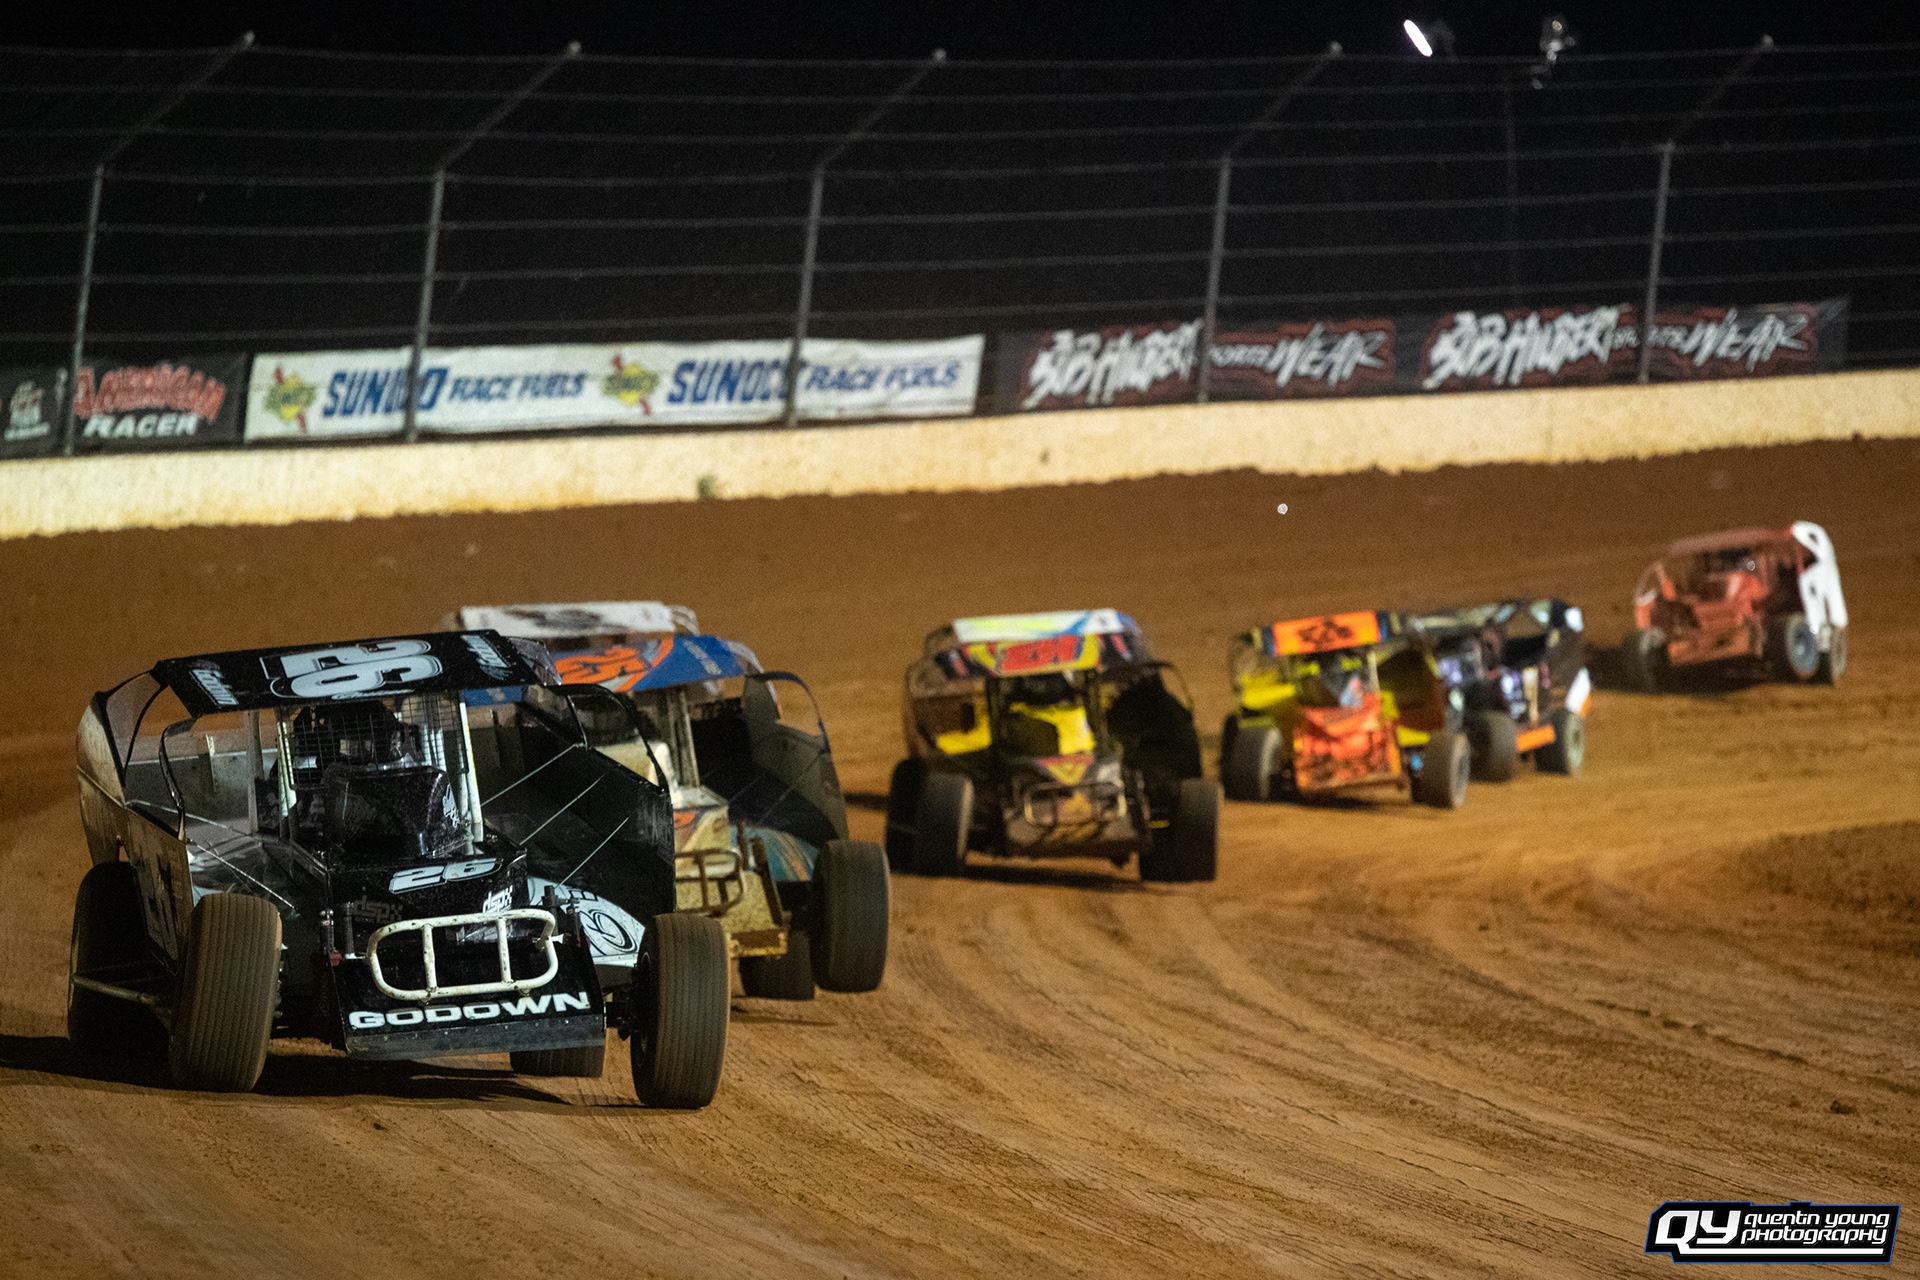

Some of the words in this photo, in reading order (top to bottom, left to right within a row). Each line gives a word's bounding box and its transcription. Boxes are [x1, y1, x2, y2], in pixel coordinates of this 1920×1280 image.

[83, 412, 199, 439] RACER
[388, 857, 504, 894] 26
[349, 991, 591, 1030] GODOWN
